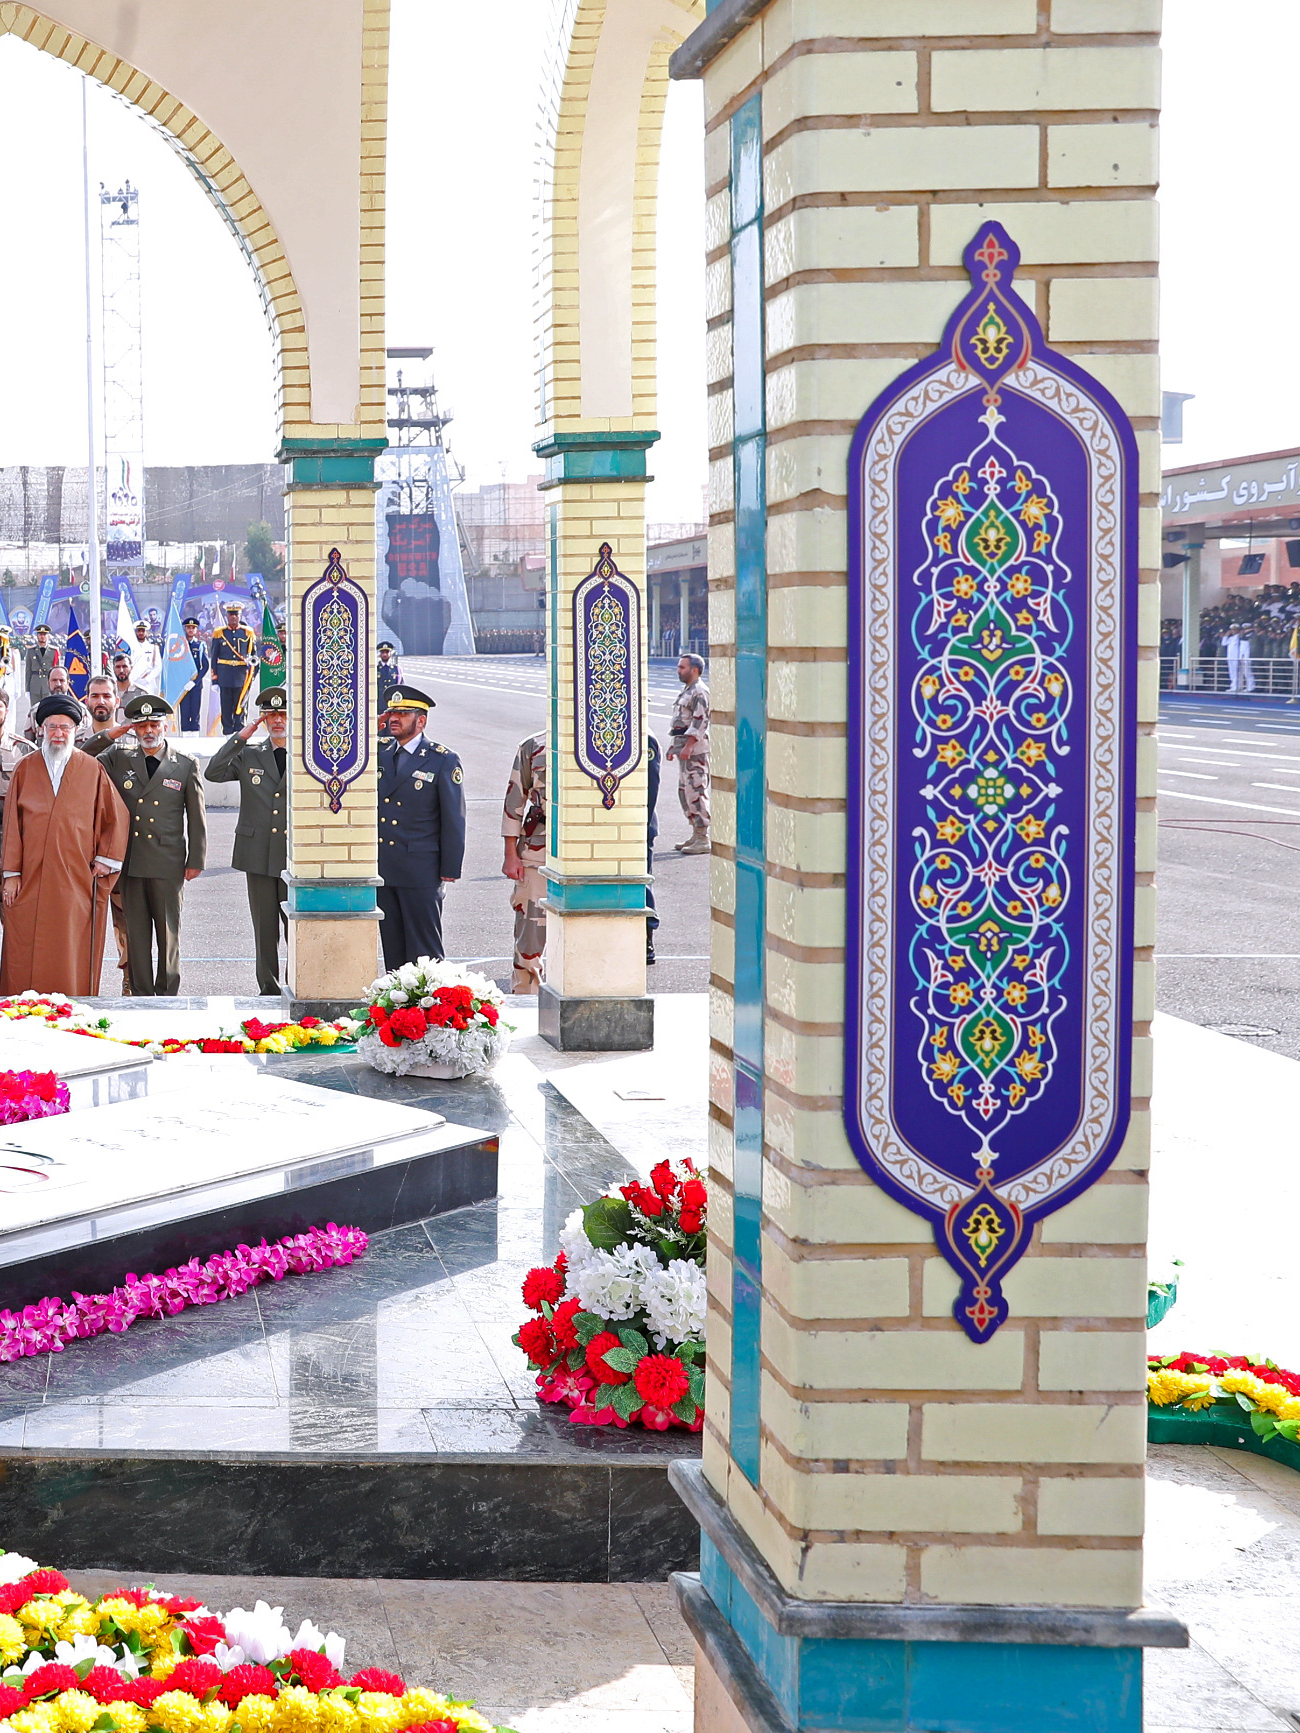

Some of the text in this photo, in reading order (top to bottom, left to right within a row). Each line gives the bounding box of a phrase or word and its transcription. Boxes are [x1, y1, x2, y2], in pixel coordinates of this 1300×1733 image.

[1171, 474, 1231, 513] کشور
[1233, 462, 1299, 506] آبروی
[398, 562, 428, 576] USA
